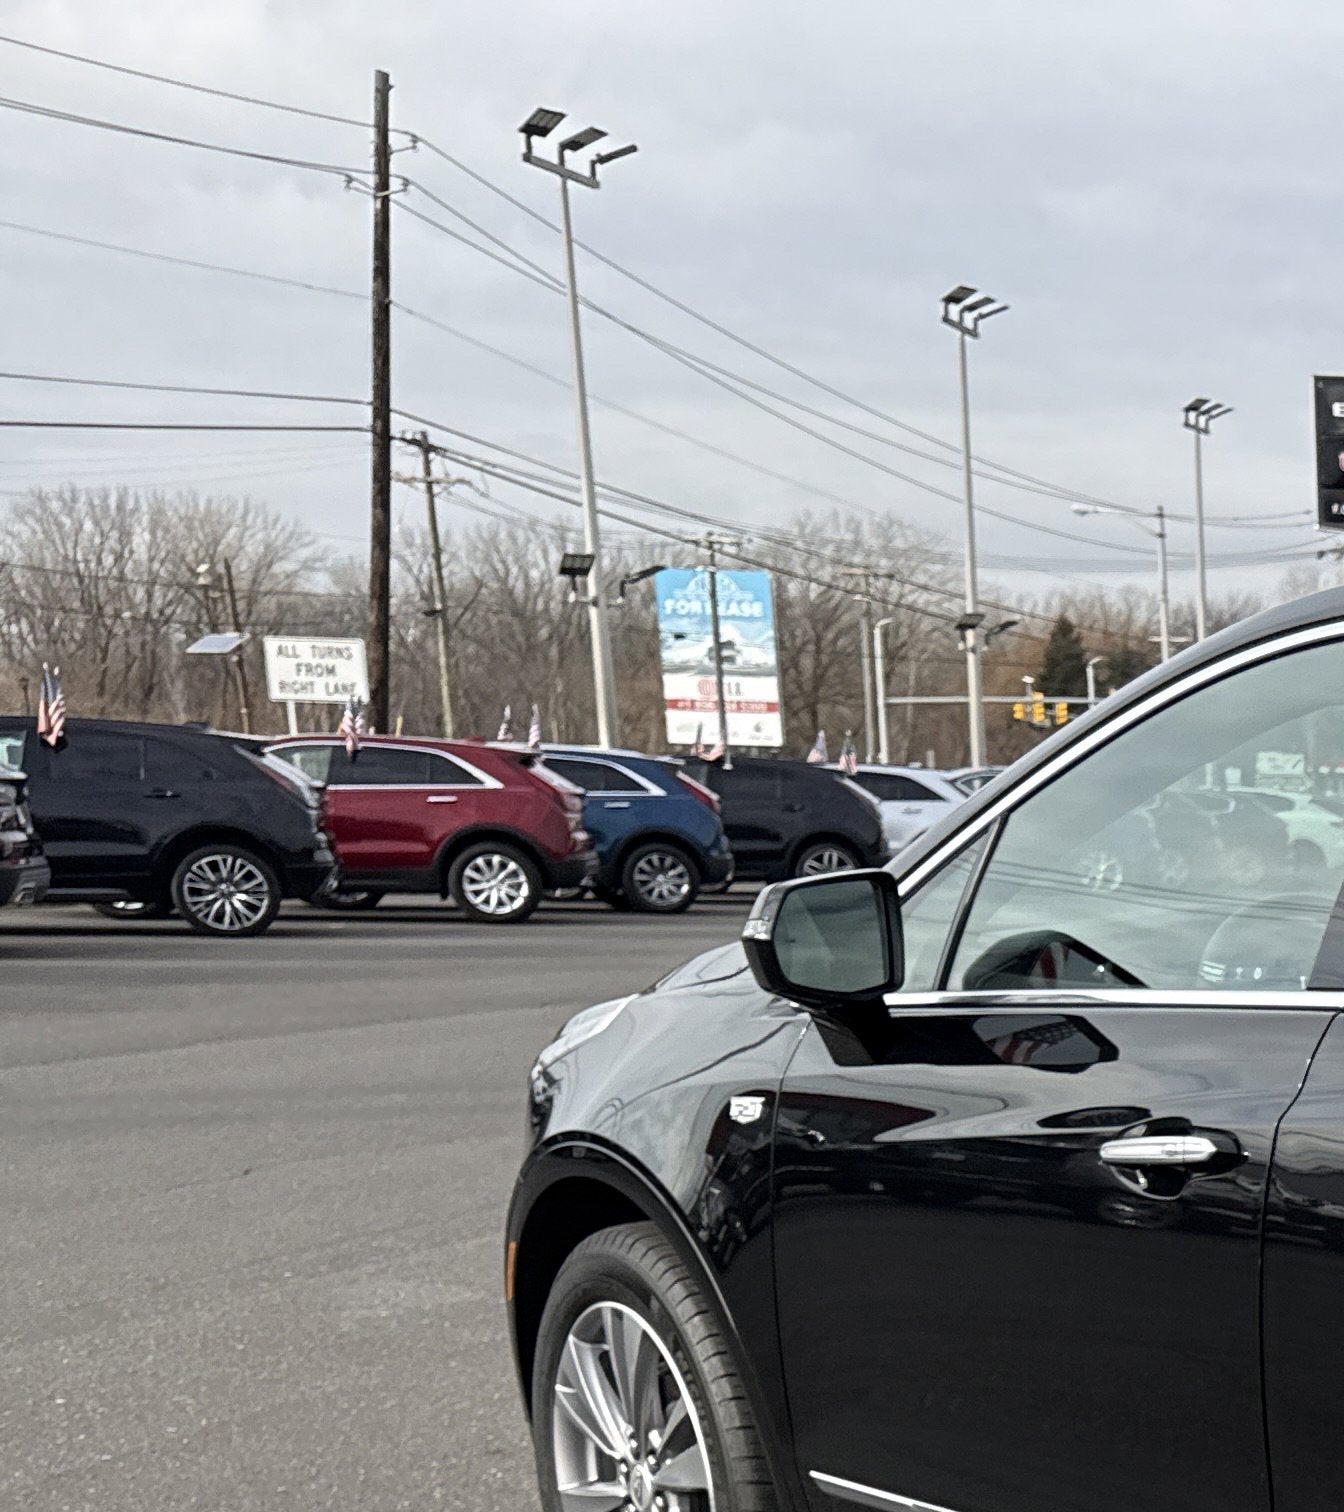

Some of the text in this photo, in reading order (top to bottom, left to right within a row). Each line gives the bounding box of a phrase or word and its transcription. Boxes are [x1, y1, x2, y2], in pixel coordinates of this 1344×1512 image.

[277, 644, 353, 661] ALL TURNS
[295, 661, 337, 678] FROM
